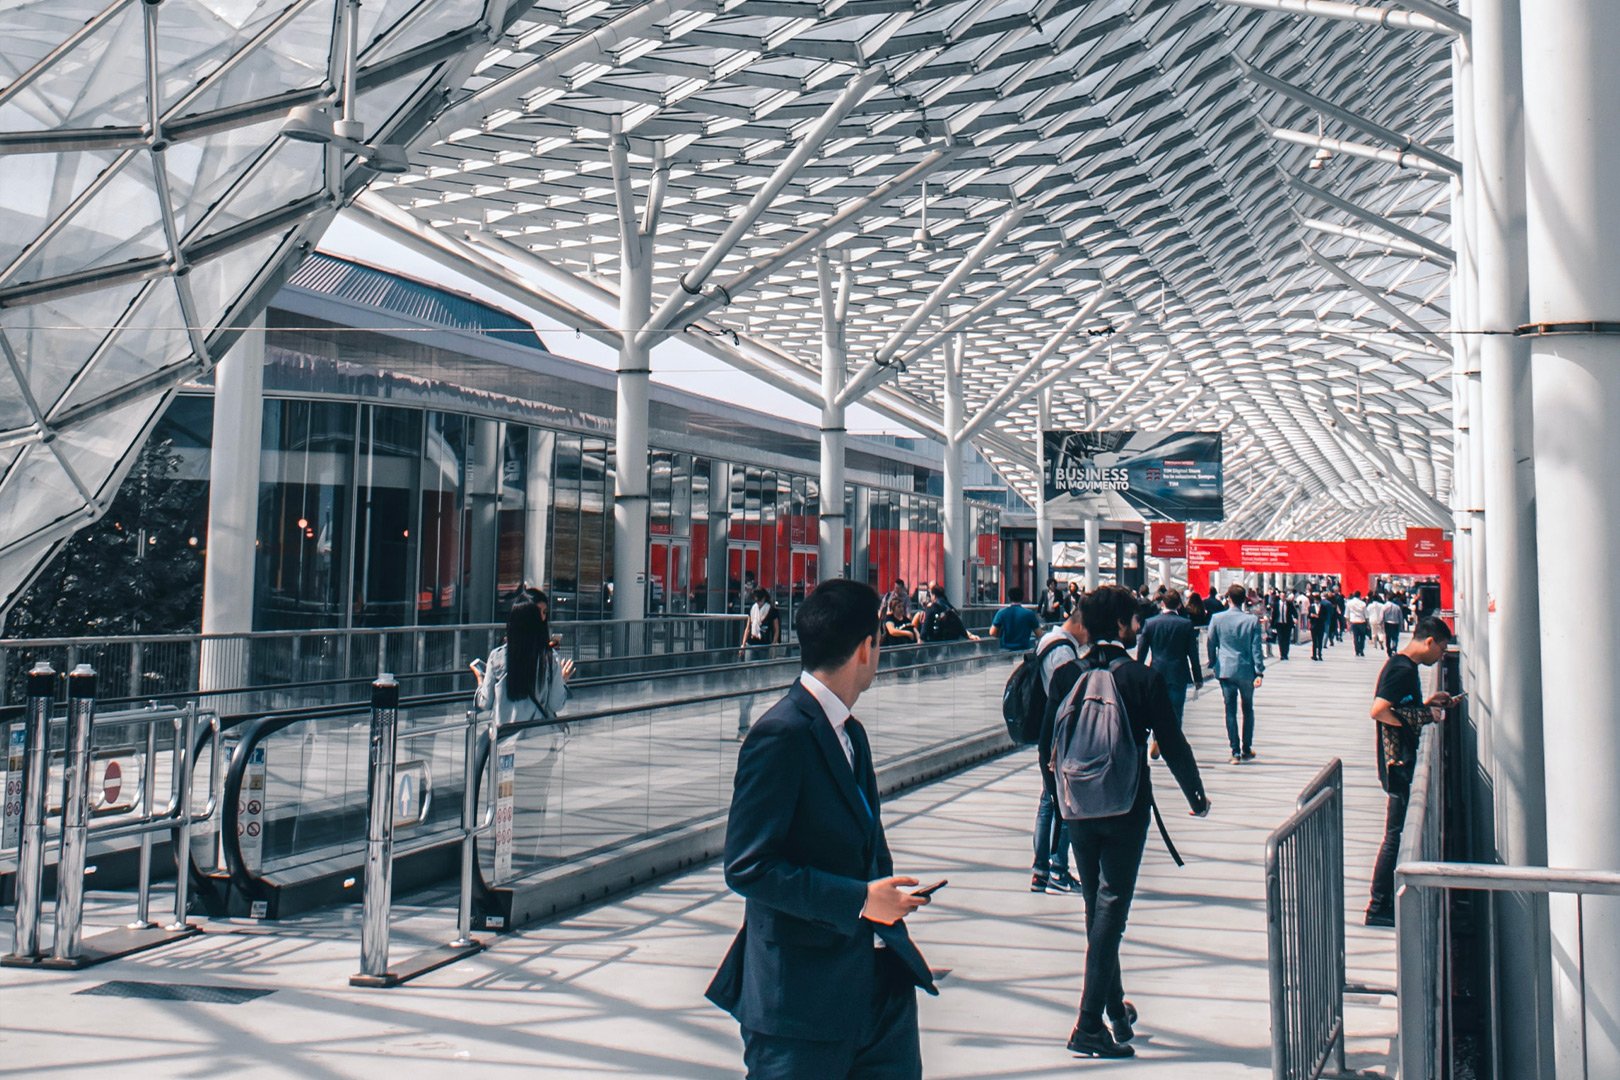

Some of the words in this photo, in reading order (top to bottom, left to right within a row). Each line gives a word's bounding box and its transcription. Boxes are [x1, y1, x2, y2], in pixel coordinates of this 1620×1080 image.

[1055, 468, 1129, 481] BUSINESS
[1055, 481, 1066, 490] IN
[1068, 481, 1130, 490] MOVIMENTO
